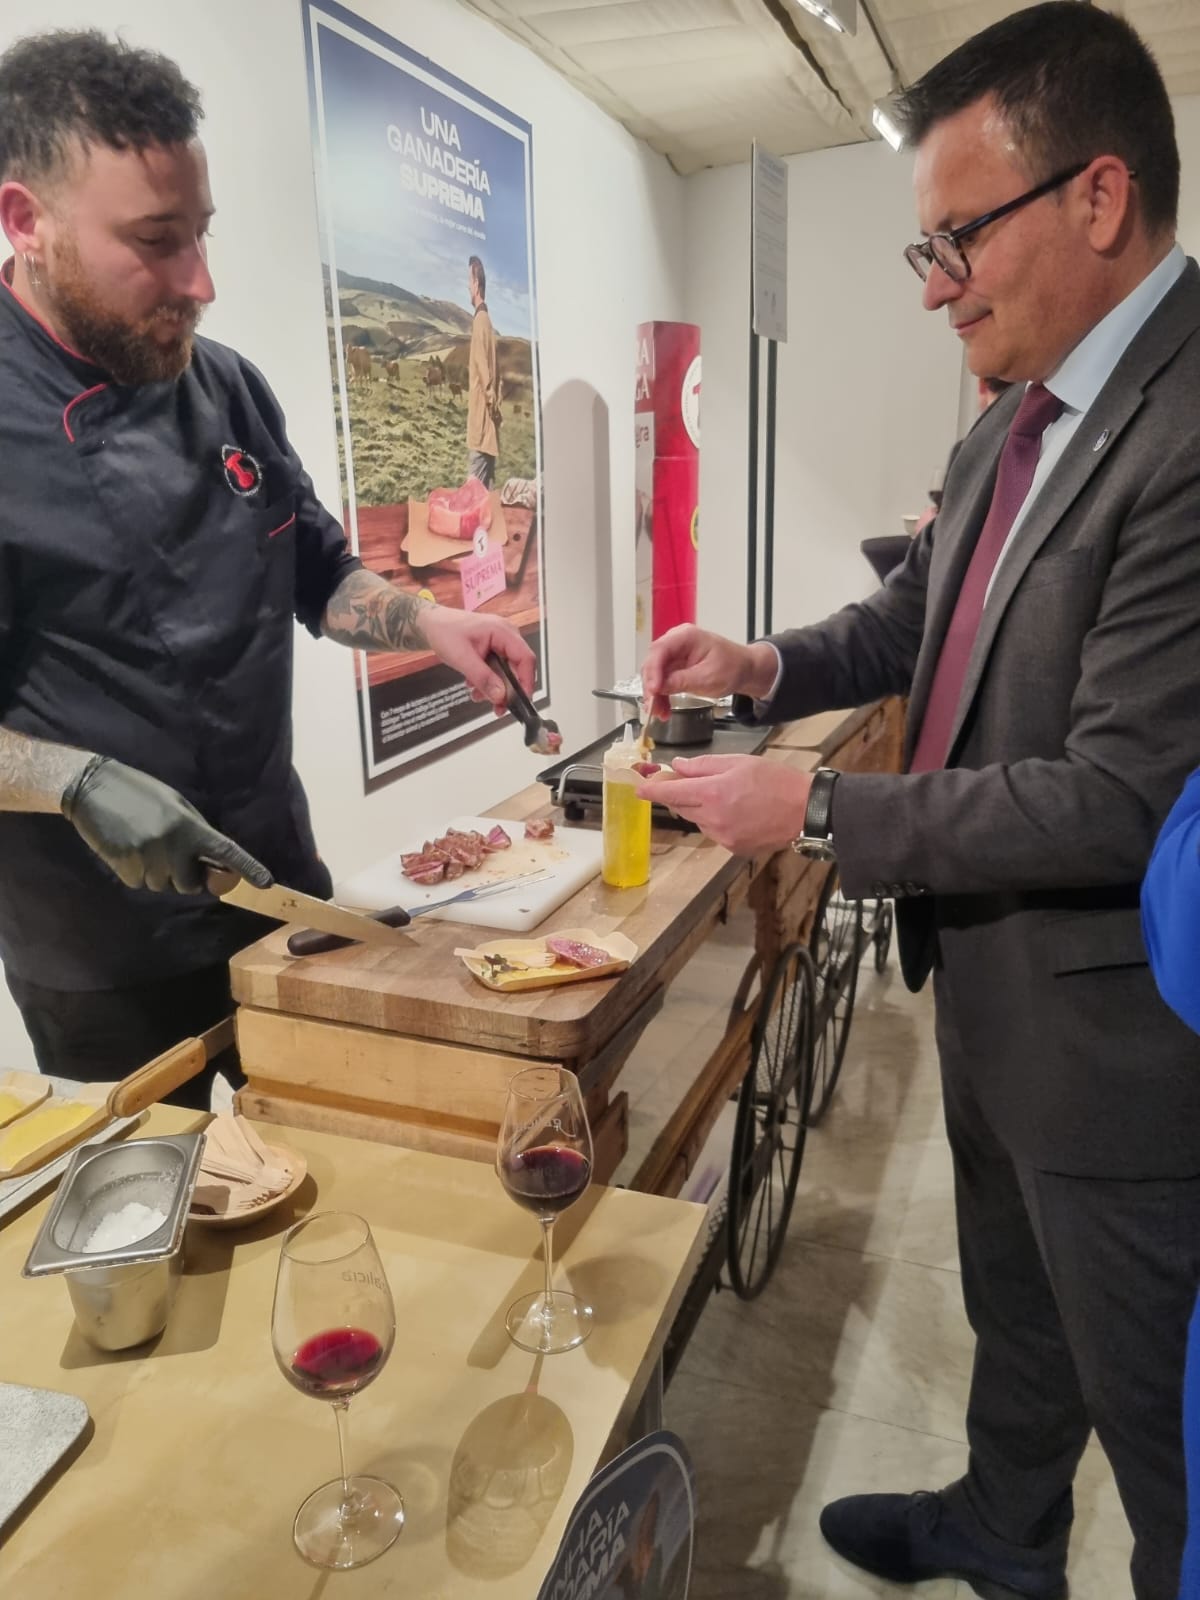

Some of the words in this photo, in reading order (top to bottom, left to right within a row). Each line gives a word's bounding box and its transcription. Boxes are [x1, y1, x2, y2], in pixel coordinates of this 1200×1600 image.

[420, 106, 461, 152] UNA
[387, 123, 491, 196] GANADERÍA
[400, 162, 485, 222] SUPREMA
